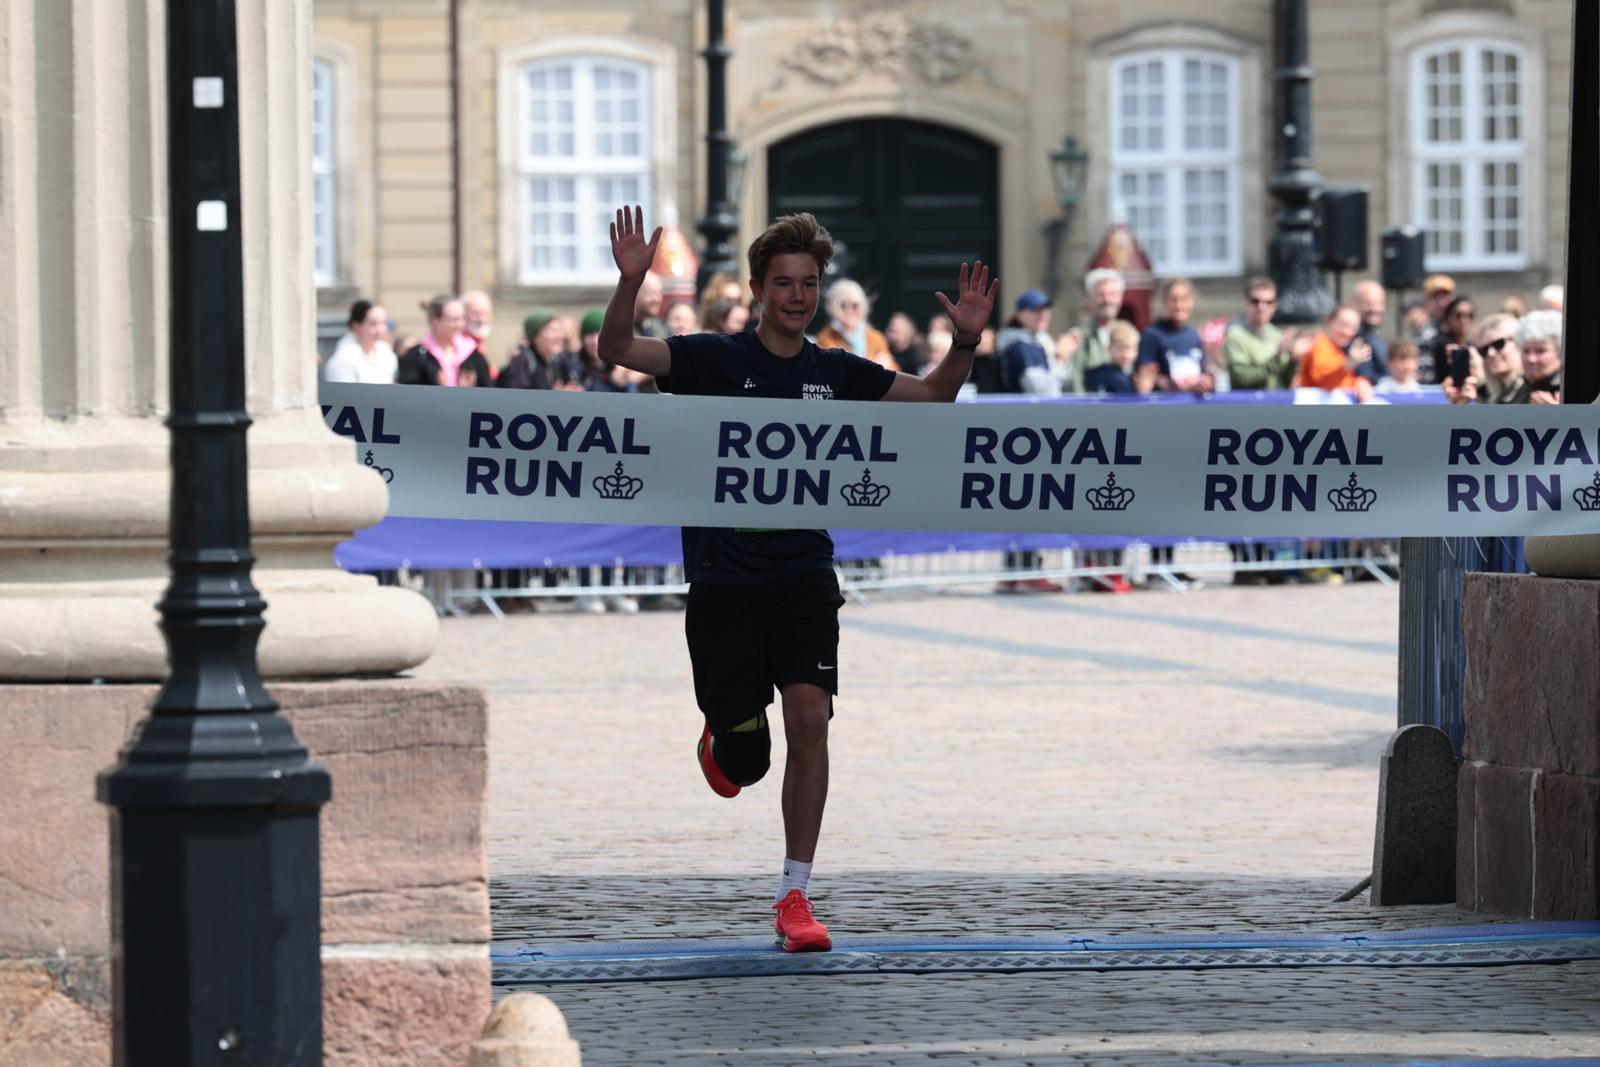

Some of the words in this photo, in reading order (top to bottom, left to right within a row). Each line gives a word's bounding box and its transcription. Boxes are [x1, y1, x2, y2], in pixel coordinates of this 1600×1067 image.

[803, 383, 834, 393] ROYAL
[468, 411, 651, 456] ROYAL
[717, 421, 898, 463] ROYAL
[964, 427, 1143, 466] ROYAL
[1207, 428, 1384, 466] ROYAL
[1448, 427, 1600, 466] ROYA
[466, 457, 583, 498] RUN
[714, 466, 831, 506] RUN
[960, 472, 1076, 511] RUN
[1204, 473, 1318, 512] RUN
[1447, 474, 1562, 512] RUN
